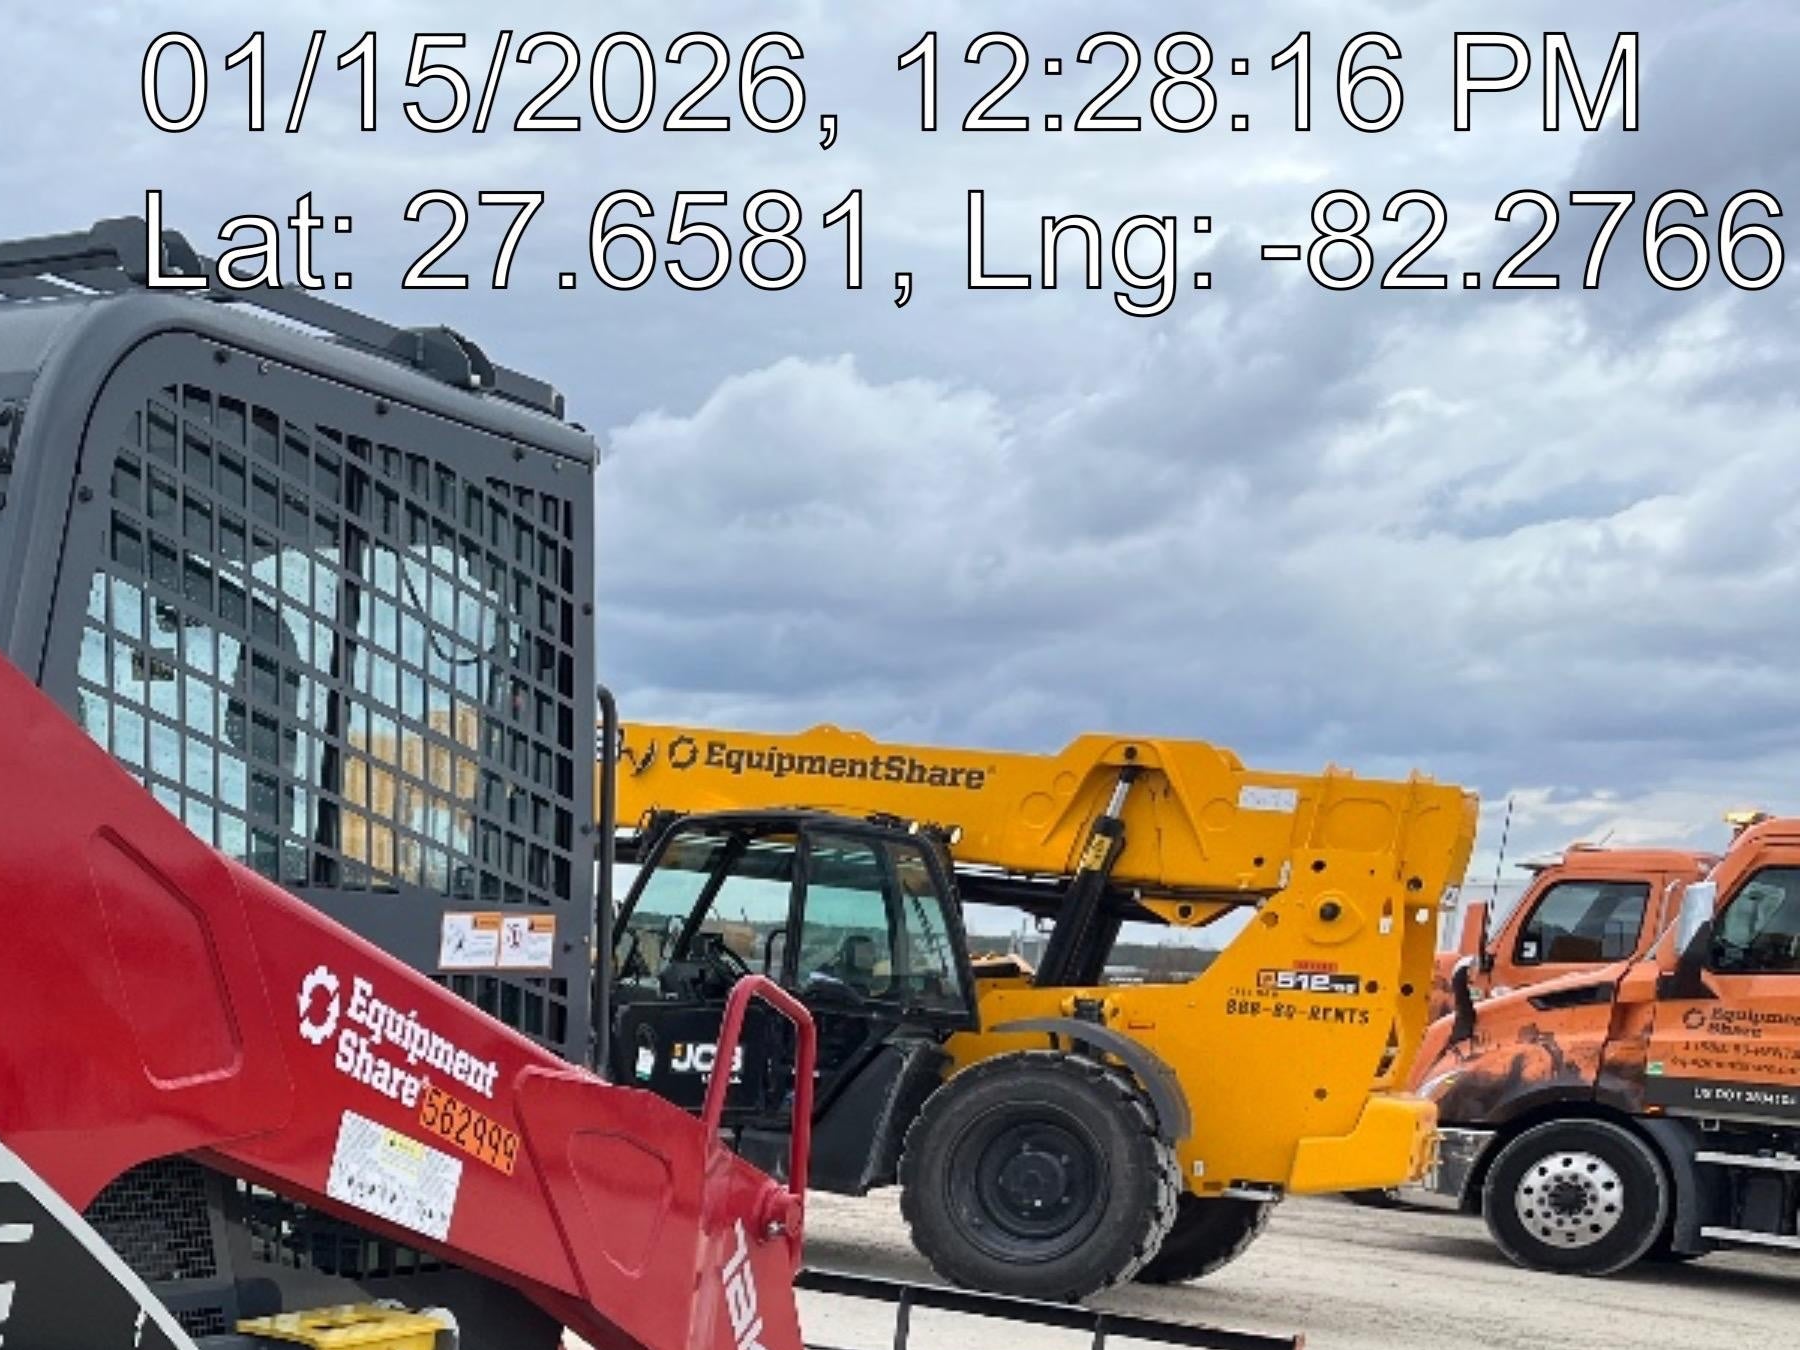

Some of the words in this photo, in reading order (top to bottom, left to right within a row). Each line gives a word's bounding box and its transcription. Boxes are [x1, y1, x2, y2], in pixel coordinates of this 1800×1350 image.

[705, 740, 986, 790] EquipmentShare
[335, 1028, 422, 1108] Share
[346, 975, 499, 1099] Equipment
[422, 1087, 517, 1171] 562999
